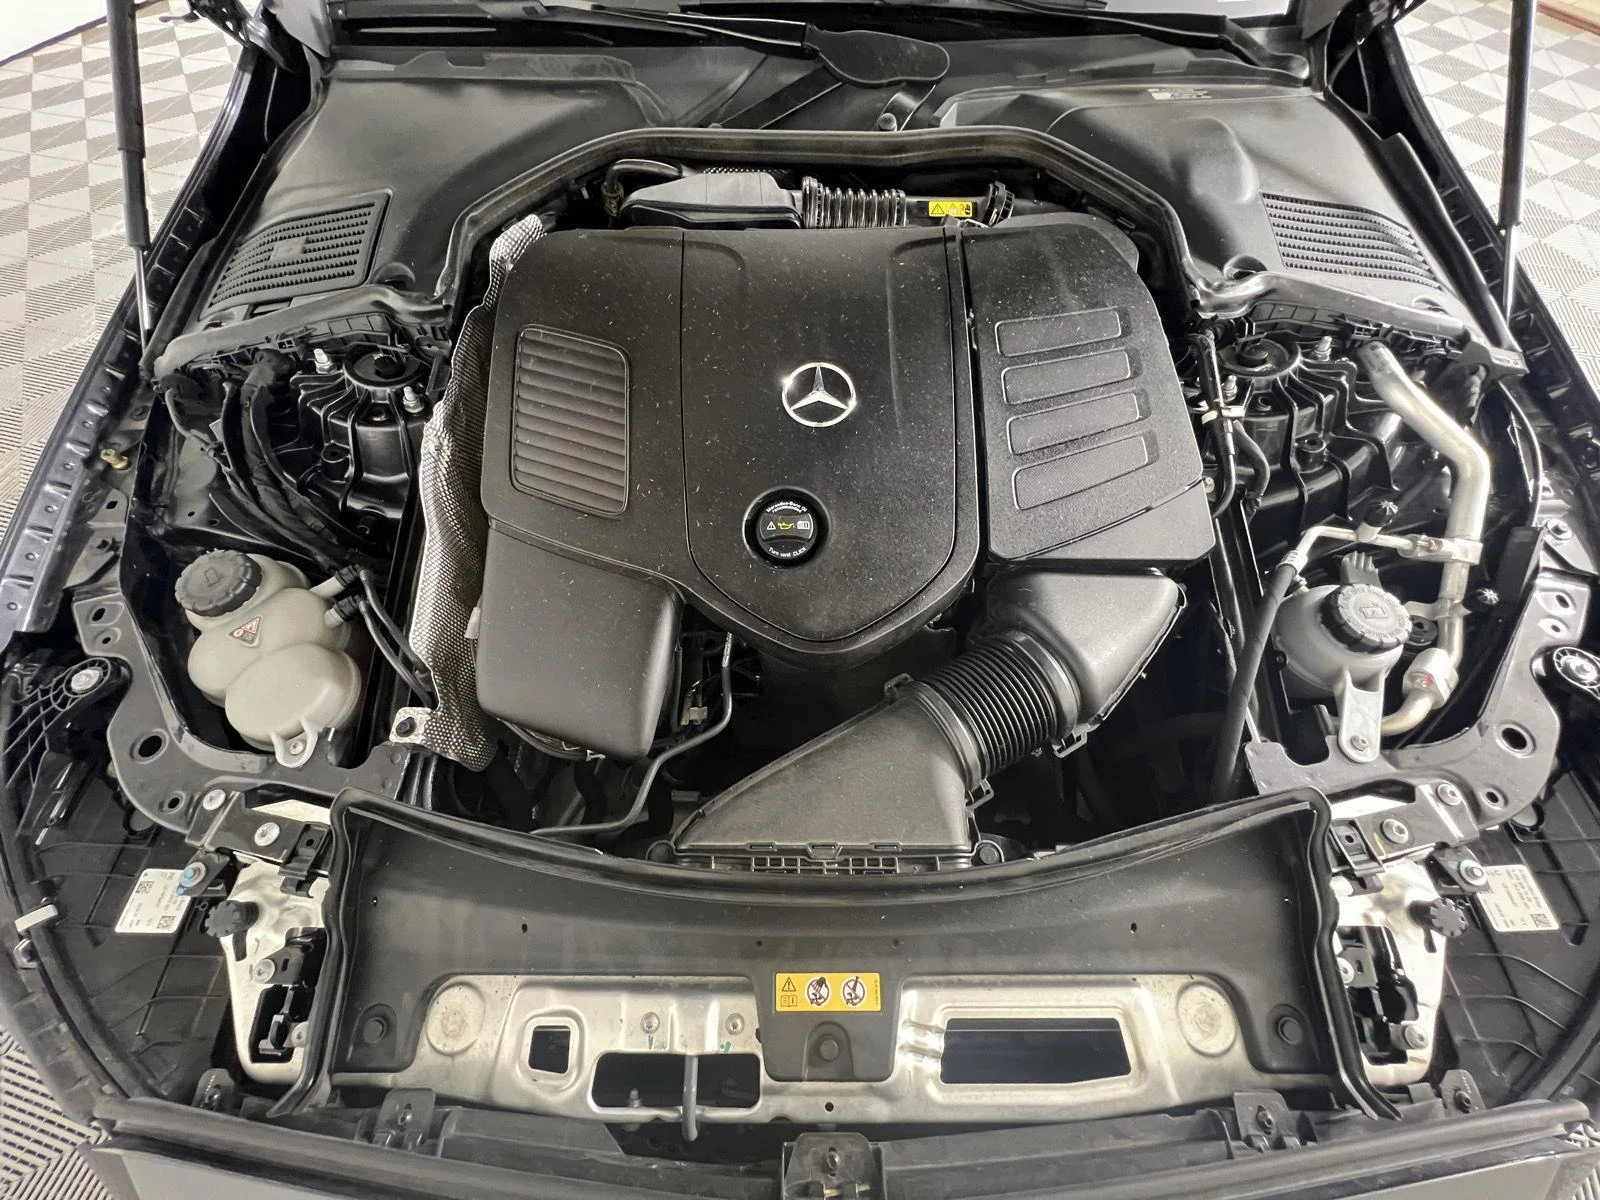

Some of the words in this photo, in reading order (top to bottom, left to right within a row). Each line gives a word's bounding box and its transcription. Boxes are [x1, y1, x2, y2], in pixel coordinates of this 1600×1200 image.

[766, 501, 801, 512] Mercedes-Benz
[768, 547, 779, 556] Turn
[793, 547, 806, 556] CLICK
